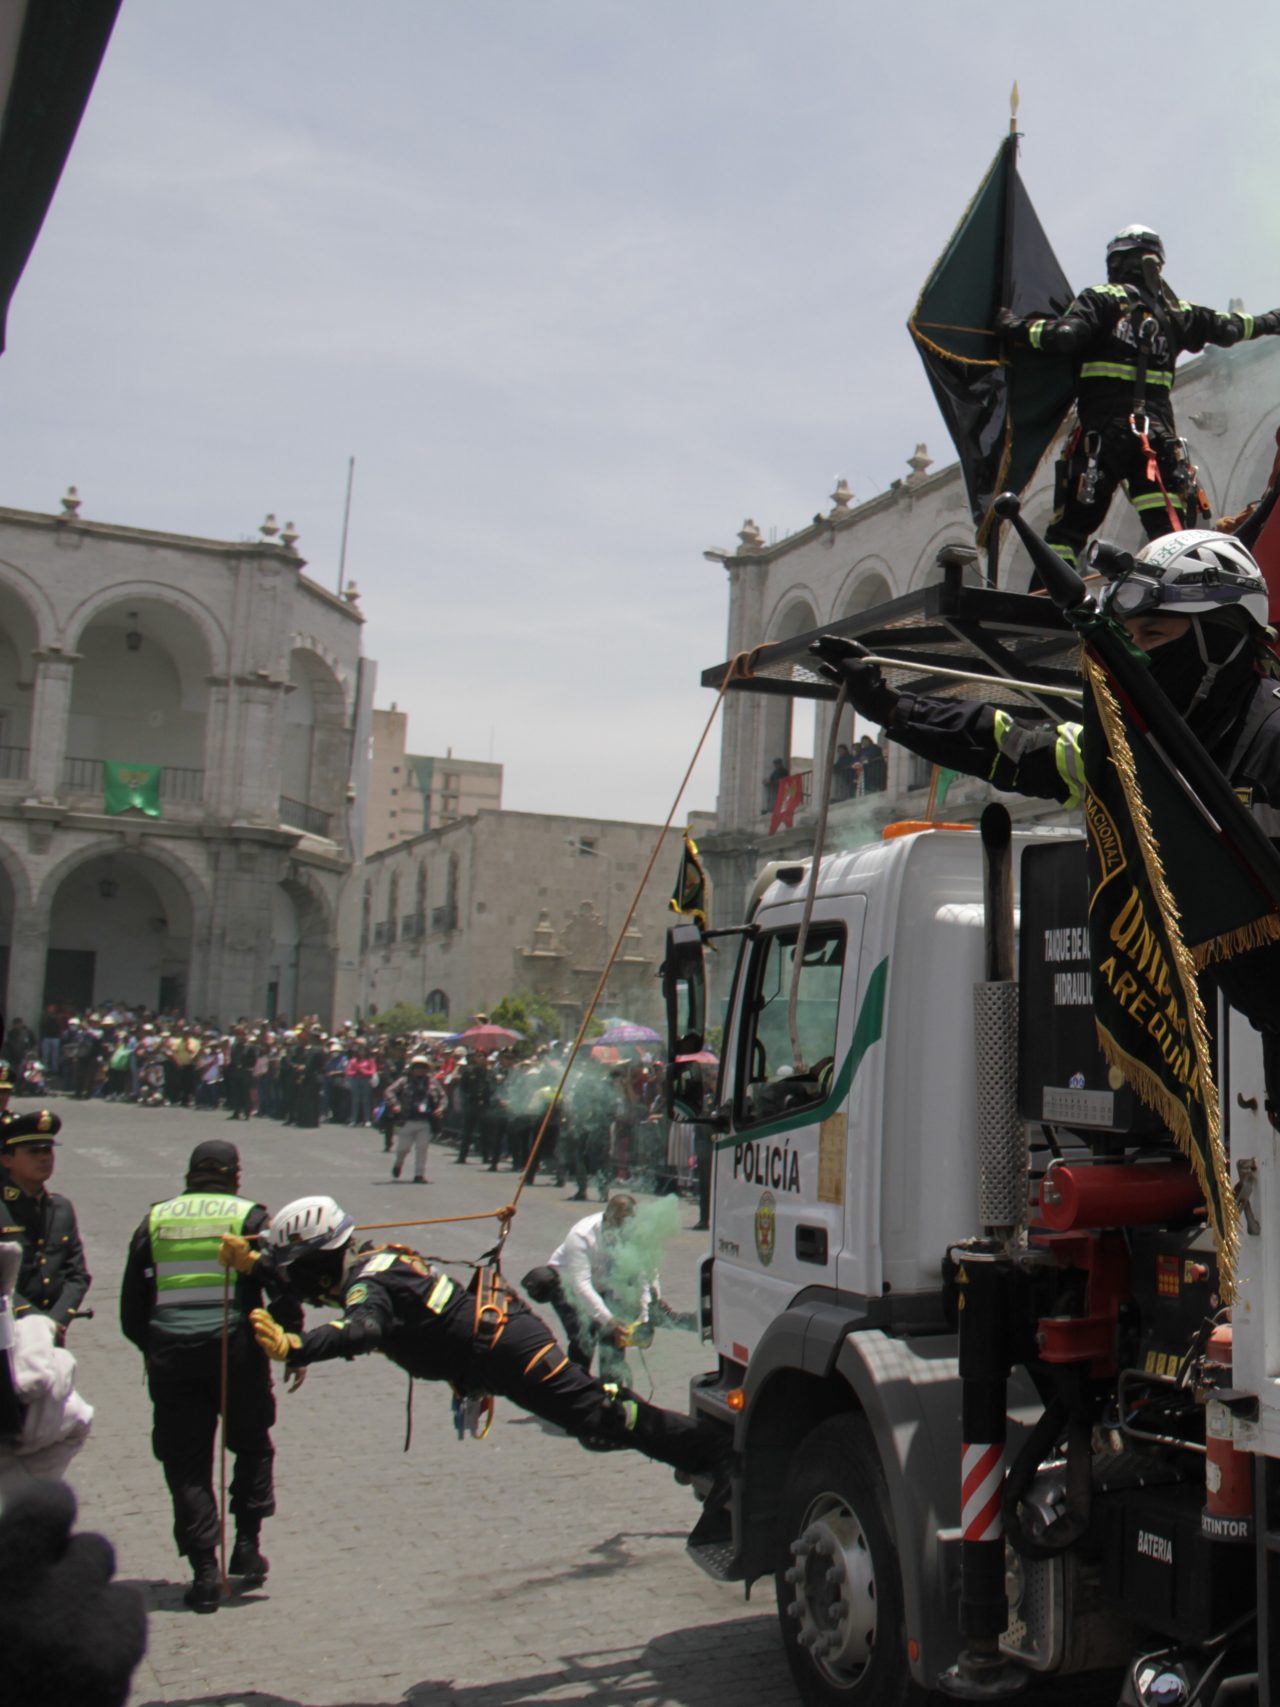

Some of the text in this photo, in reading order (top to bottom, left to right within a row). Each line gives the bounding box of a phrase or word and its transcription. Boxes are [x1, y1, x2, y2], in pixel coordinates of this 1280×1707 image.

[1085, 795, 1117, 868] NACIONAL
[1055, 972, 1094, 1005] HIDRAULIC
[733, 1138, 801, 1194] POLICÍA
[158, 1199, 239, 1218] POLICIA
[1137, 1530, 1173, 1564] BATERIA
